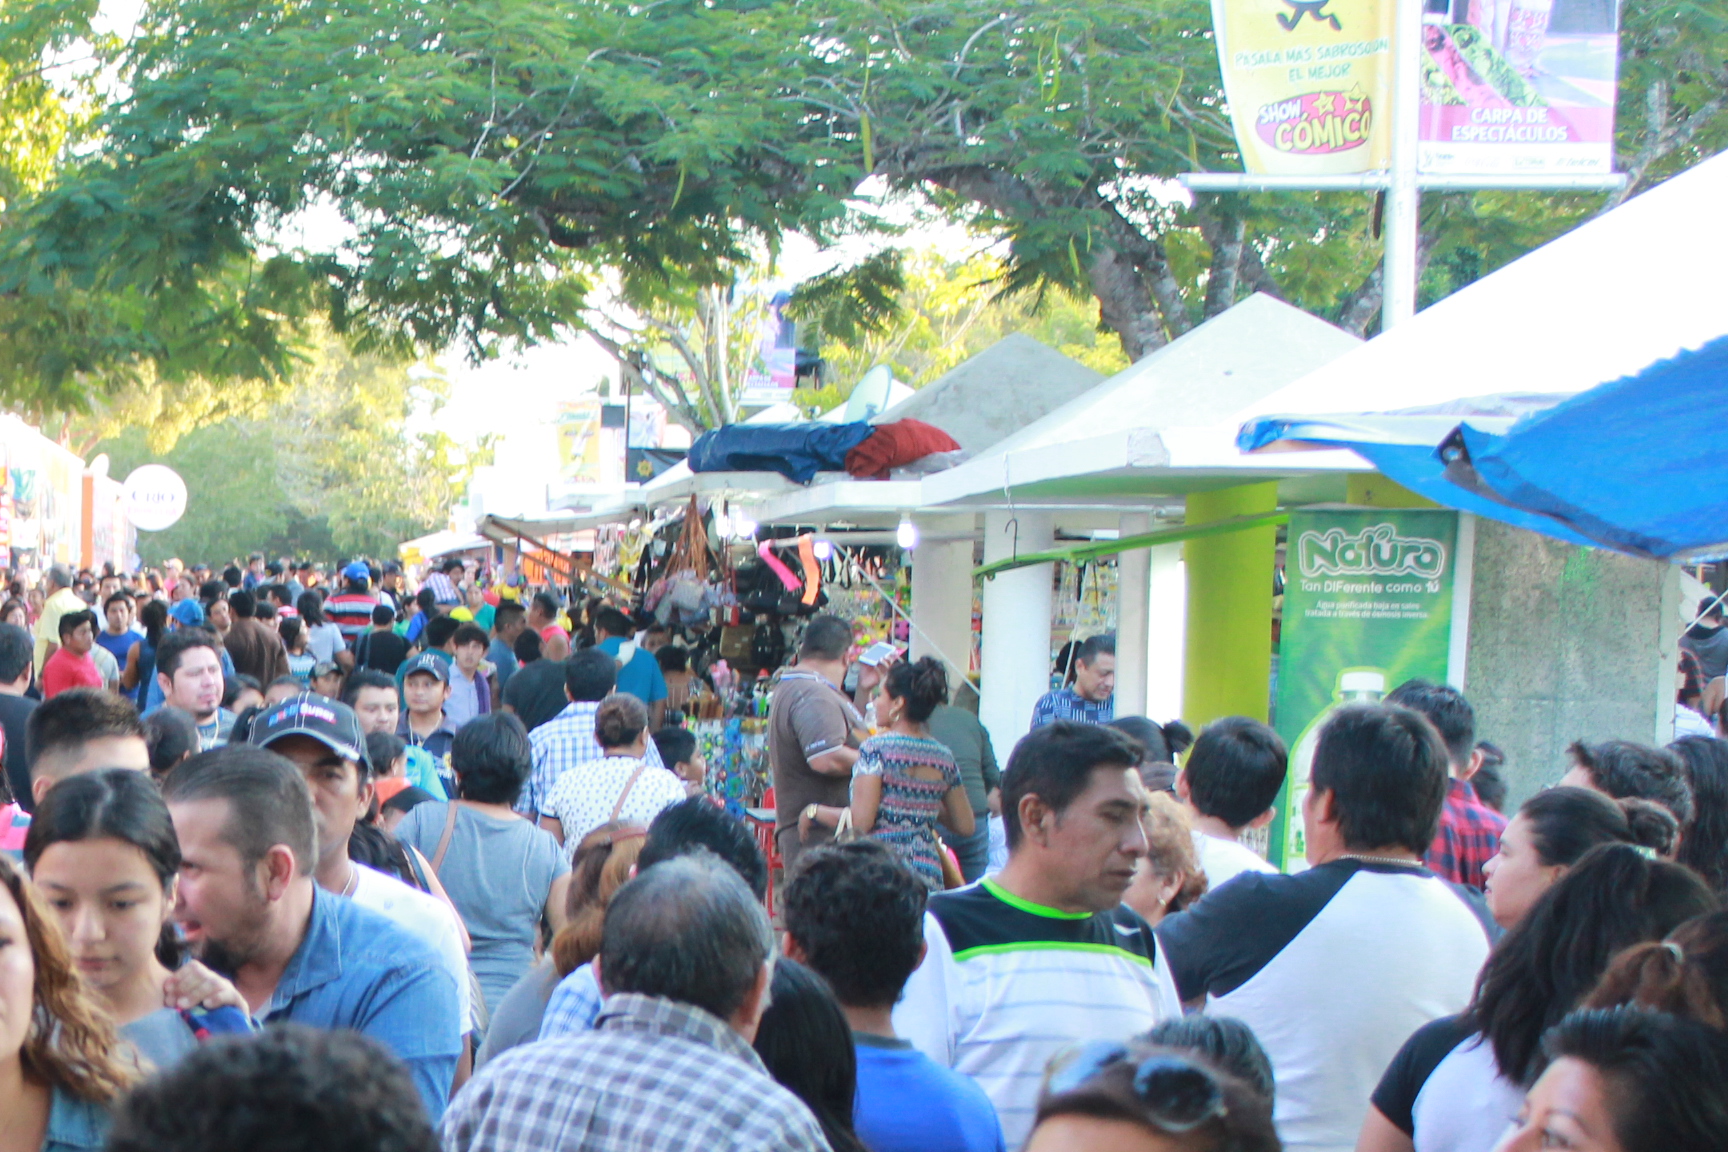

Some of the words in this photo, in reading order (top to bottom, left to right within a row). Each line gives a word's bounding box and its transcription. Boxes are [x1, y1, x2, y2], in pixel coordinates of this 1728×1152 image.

[1289, 67, 1304, 82] EL
[1308, 62, 1352, 80] MEJOR
[1259, 99, 1302, 124] SHOW
[1471, 107, 1523, 124] CARPA
[1527, 107, 1548, 124] DE
[1275, 112, 1371, 151] CÓMICO
[1452, 124, 1567, 142] ESPECTÁCULOS
[1302, 526, 1443, 576] Natura
[1300, 580, 1321, 593] Tan
[1324, 580, 1384, 594] DIFerente
[1386, 582, 1422, 593] como
[1425, 578, 1440, 593] tú
